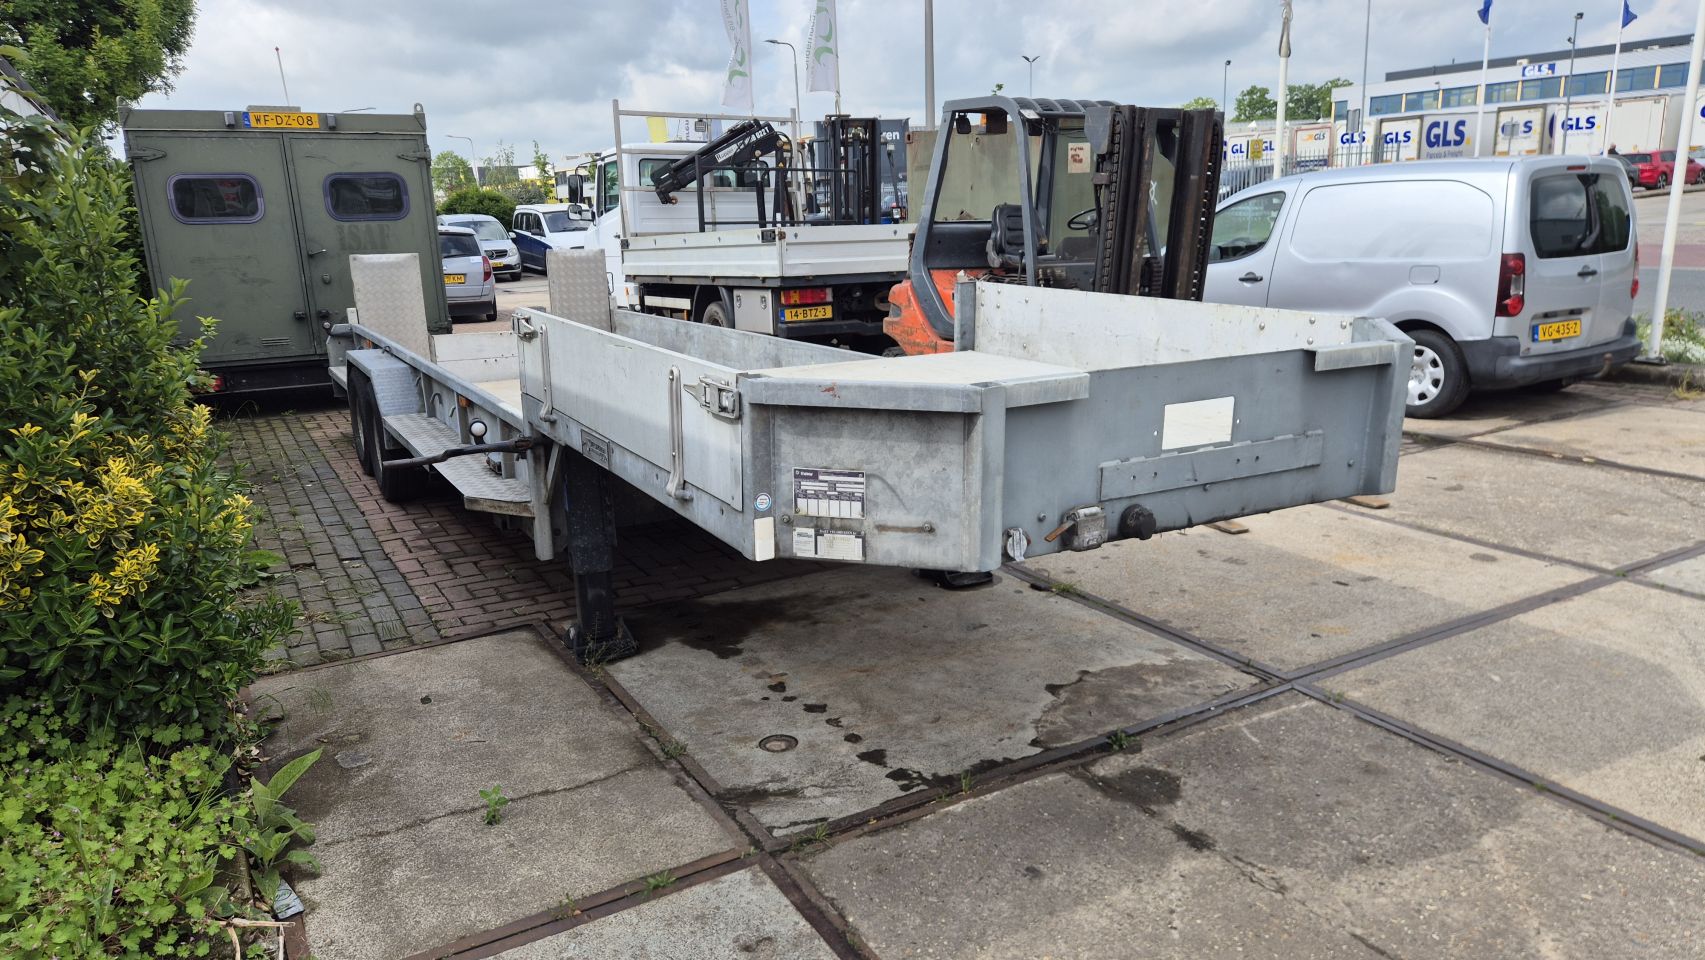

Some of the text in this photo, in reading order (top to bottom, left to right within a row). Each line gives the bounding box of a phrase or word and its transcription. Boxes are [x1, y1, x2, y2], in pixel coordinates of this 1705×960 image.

[1524, 64, 1549, 77] GLS
[253, 114, 314, 126] WF-DZ-08
[1561, 116, 1596, 132] GLS
[1314, 132, 1325, 141] GLS
[1385, 130, 1412, 144] GLS
[1425, 119, 1466, 148] GLS
[1231, 143, 1245, 154] GL
[1262, 140, 1275, 151] GL
[789, 307, 827, 319] 14-BTZ-3
[1541, 321, 1578, 337] VG-435-Z
